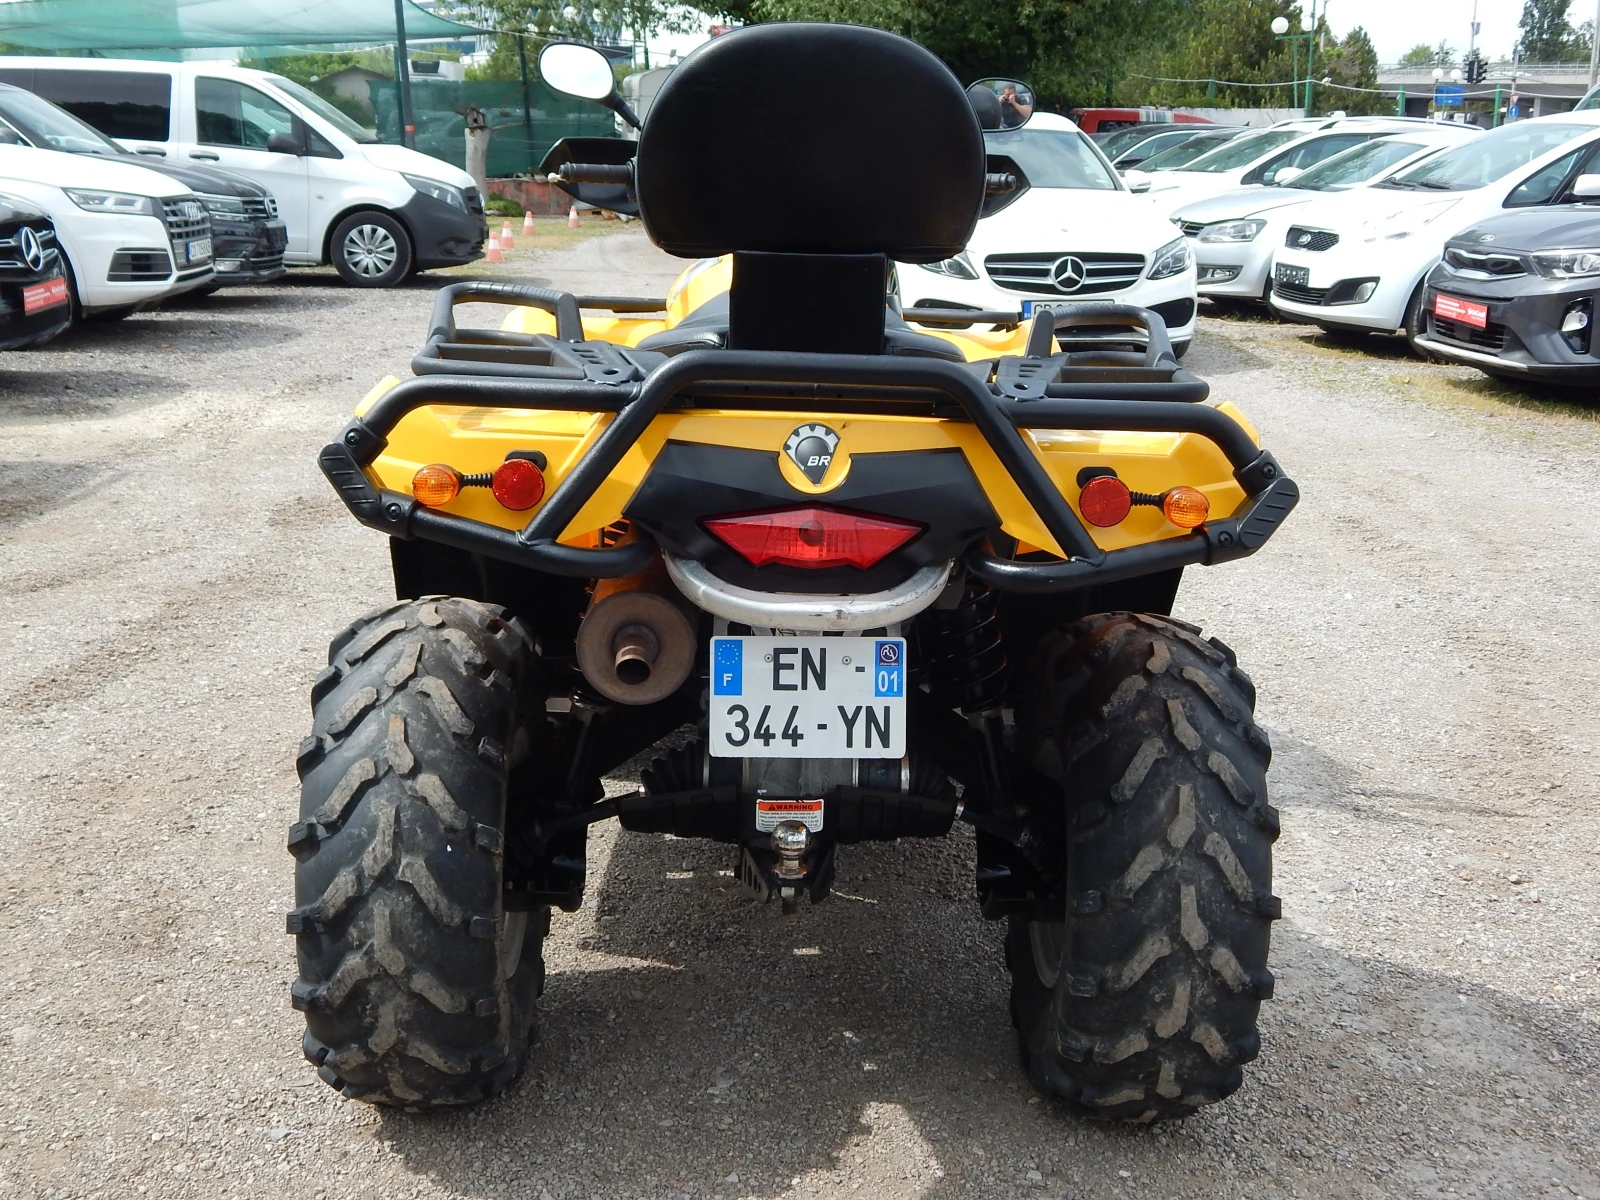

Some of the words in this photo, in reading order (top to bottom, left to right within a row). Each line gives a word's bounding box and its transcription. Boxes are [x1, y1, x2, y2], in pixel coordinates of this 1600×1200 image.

[807, 456, 831, 466] BR
[773, 647, 827, 691] EN
[723, 673, 733, 687] F
[878, 670, 898, 692] 01
